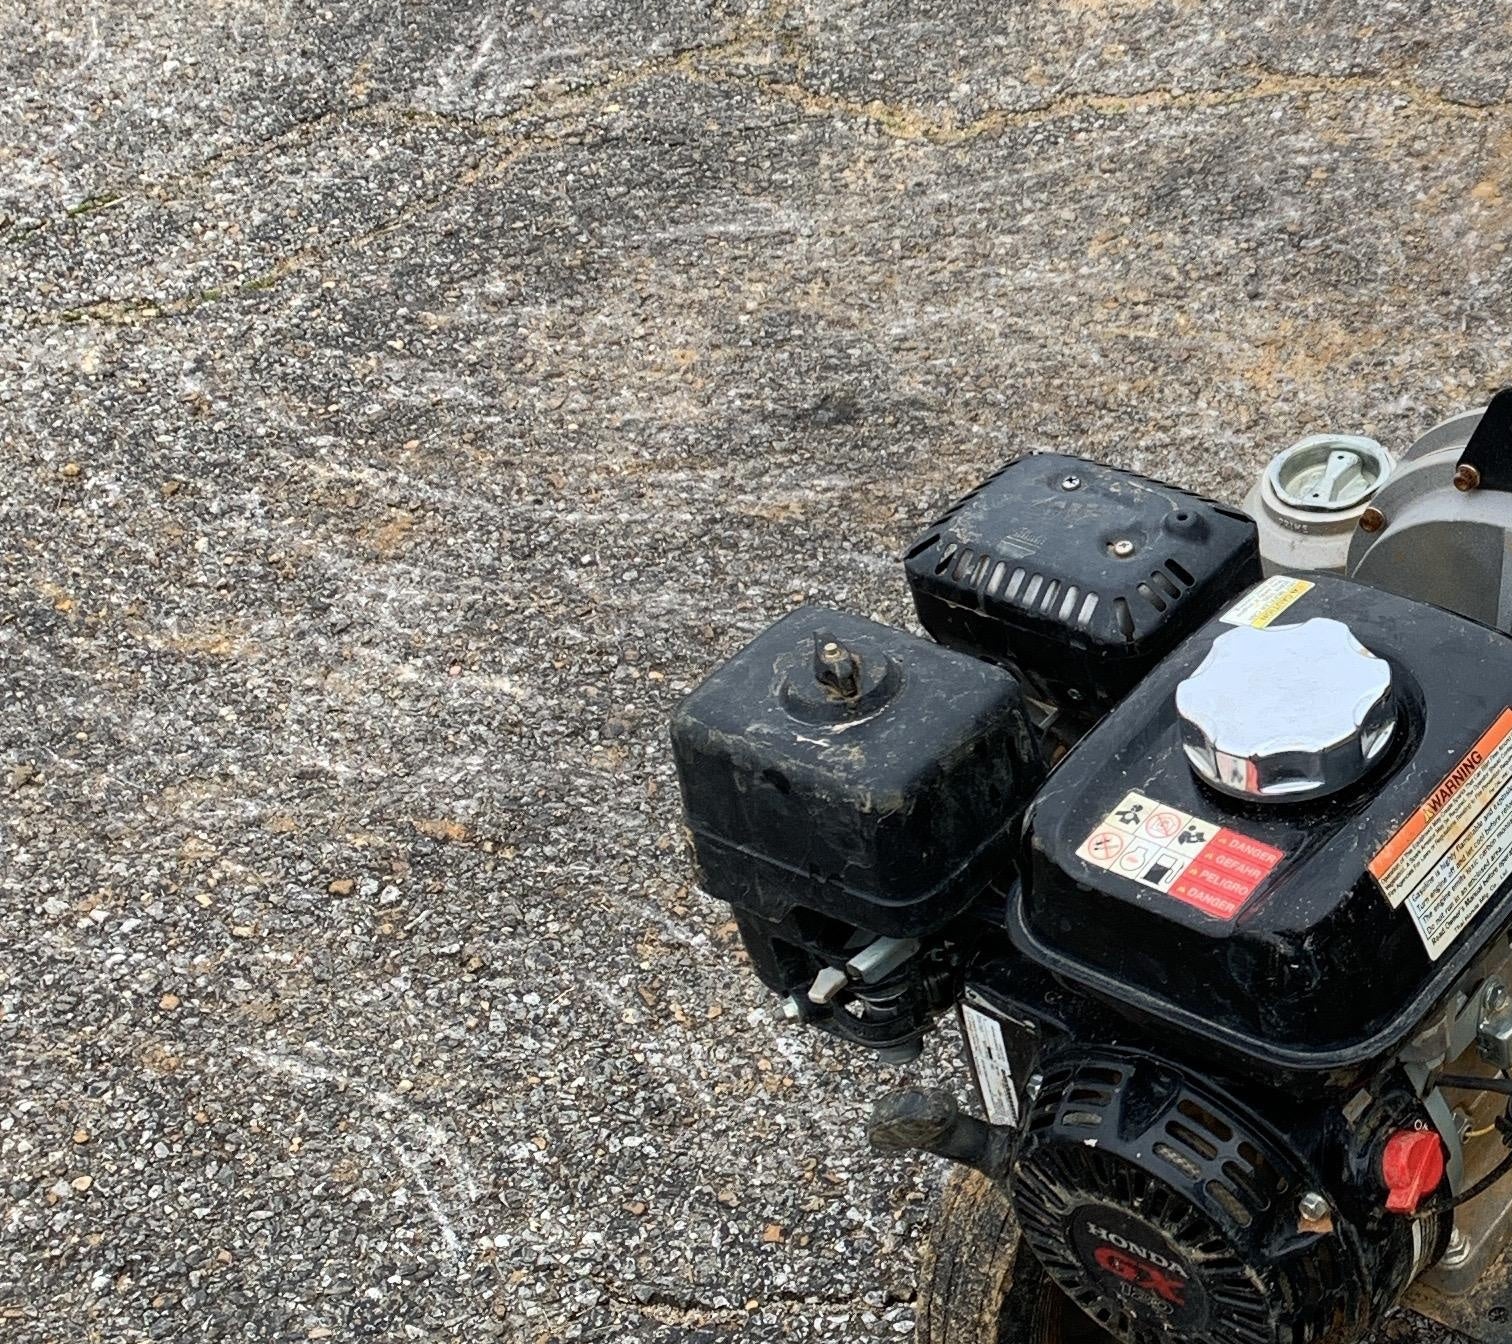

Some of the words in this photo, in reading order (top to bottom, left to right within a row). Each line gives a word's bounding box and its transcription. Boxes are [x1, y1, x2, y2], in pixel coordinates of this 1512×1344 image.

[1431, 750, 1483, 812] WARNING
[1215, 855, 1262, 878] GEFAHR
[1228, 839, 1278, 862] DANGER
[1187, 887, 1236, 912] DANGER
[1199, 869, 1248, 895] PELIGRO
[1416, 894, 1429, 912] Turn
[1455, 853, 1466, 868] and
[1422, 909, 1433, 923] The
[1431, 926, 1445, 945] Read
[1463, 883, 1482, 907] Manual
[1086, 1221, 1190, 1279] HONDA
[1094, 1247, 1185, 1306] GX
